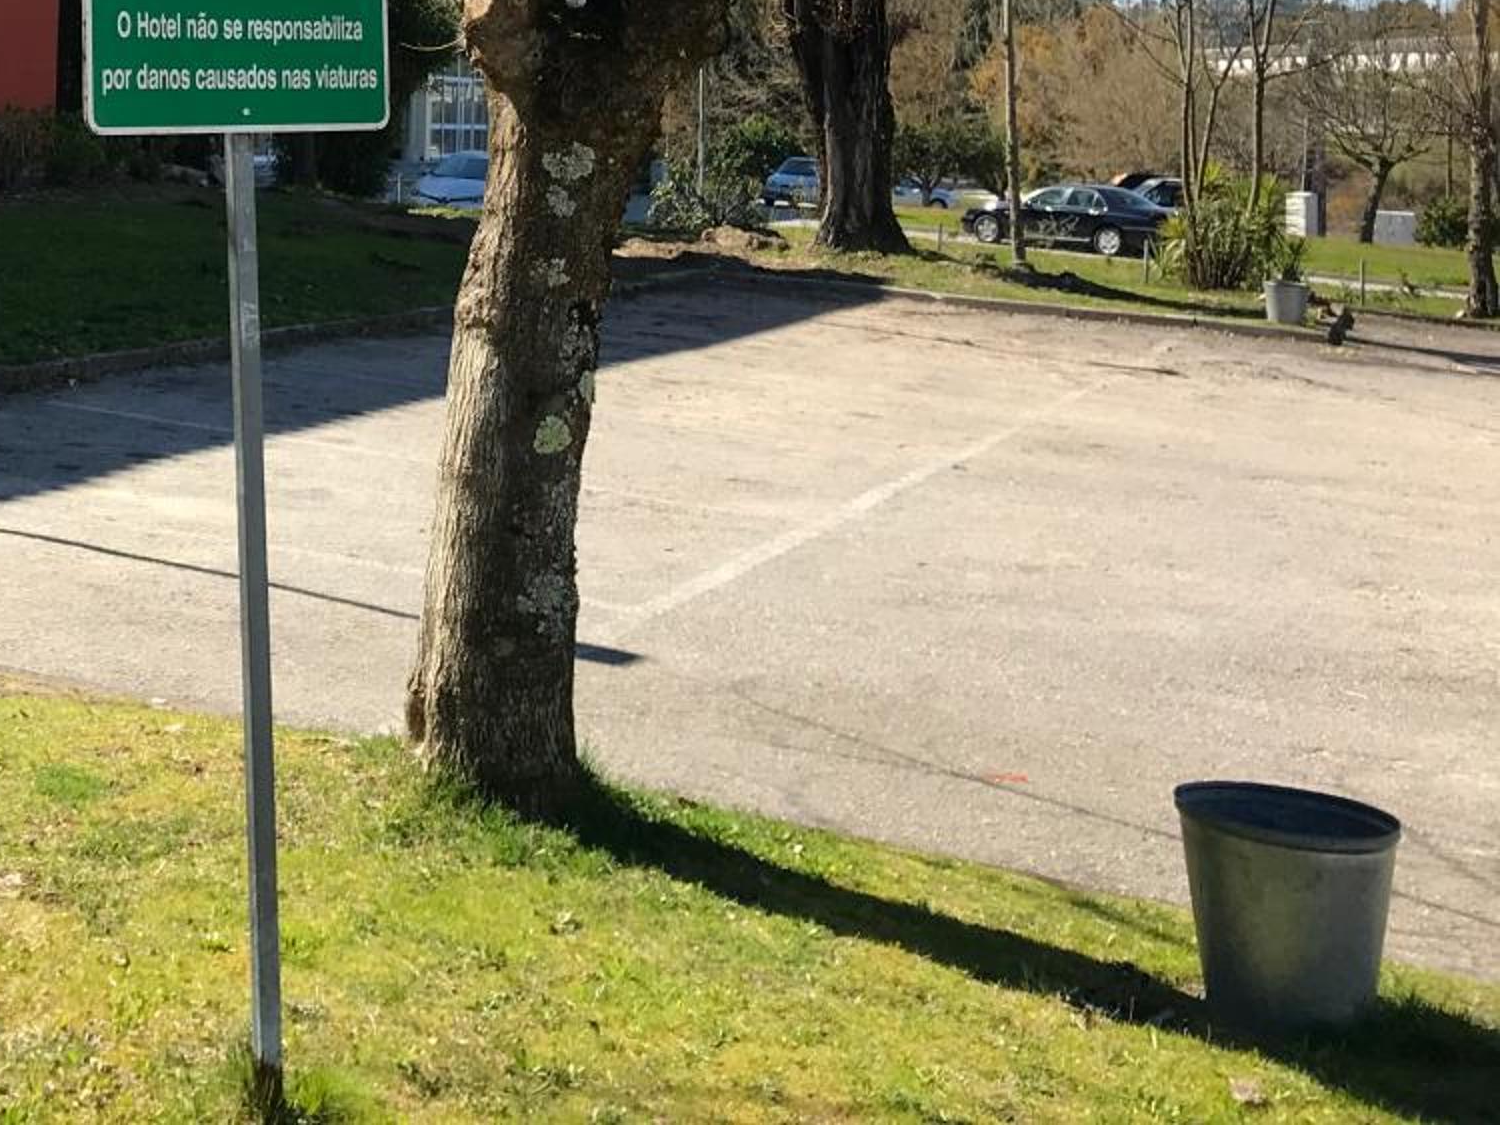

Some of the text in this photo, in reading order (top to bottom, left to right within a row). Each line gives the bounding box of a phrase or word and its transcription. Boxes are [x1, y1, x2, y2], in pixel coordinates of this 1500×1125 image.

[118, 11, 362, 45] O Hotel não se responsabiliza
[102, 64, 377, 95] por danos causados nas viaturas
